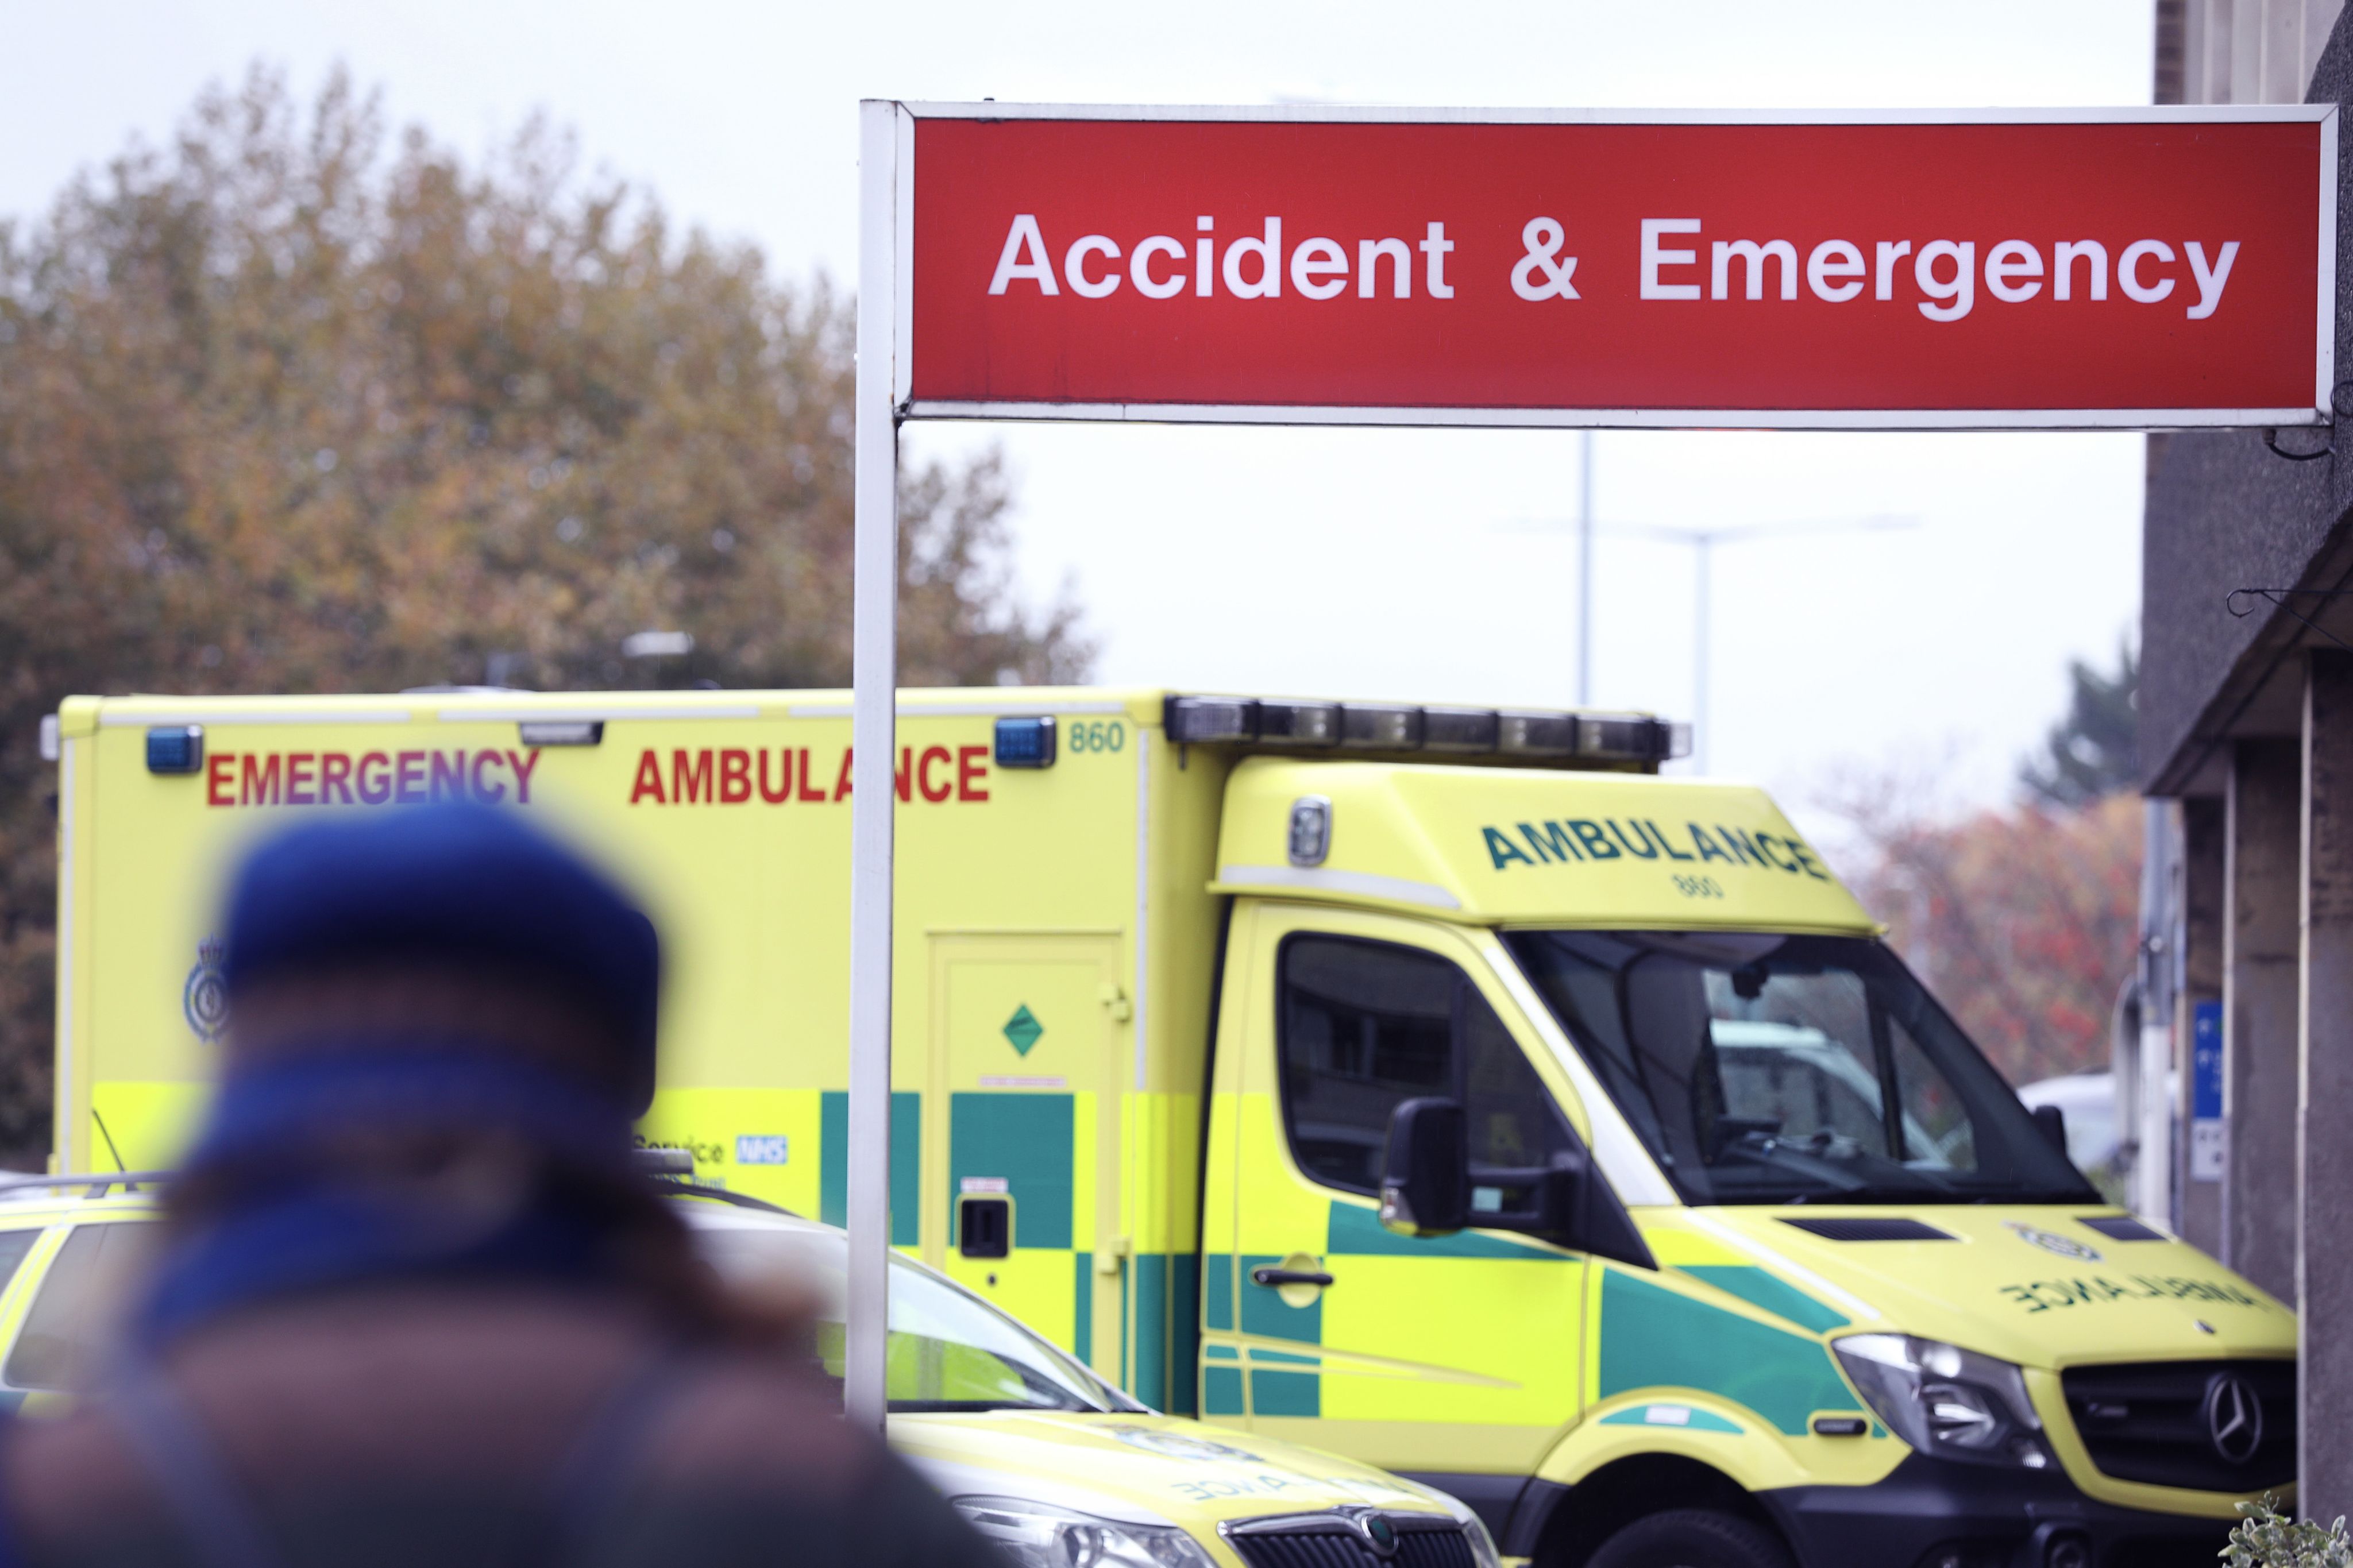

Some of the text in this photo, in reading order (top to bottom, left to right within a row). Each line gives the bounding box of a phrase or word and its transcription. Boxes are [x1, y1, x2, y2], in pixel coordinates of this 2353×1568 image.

[987, 214, 2240, 322] Accident & Emergency
[1068, 720, 1125, 754] 860
[207, 748, 541, 806] EMERGENCY
[1481, 819, 1830, 882] AMBULANCE
[1671, 874, 1725, 899] 860
[736, 1136, 788, 1164] NHS
